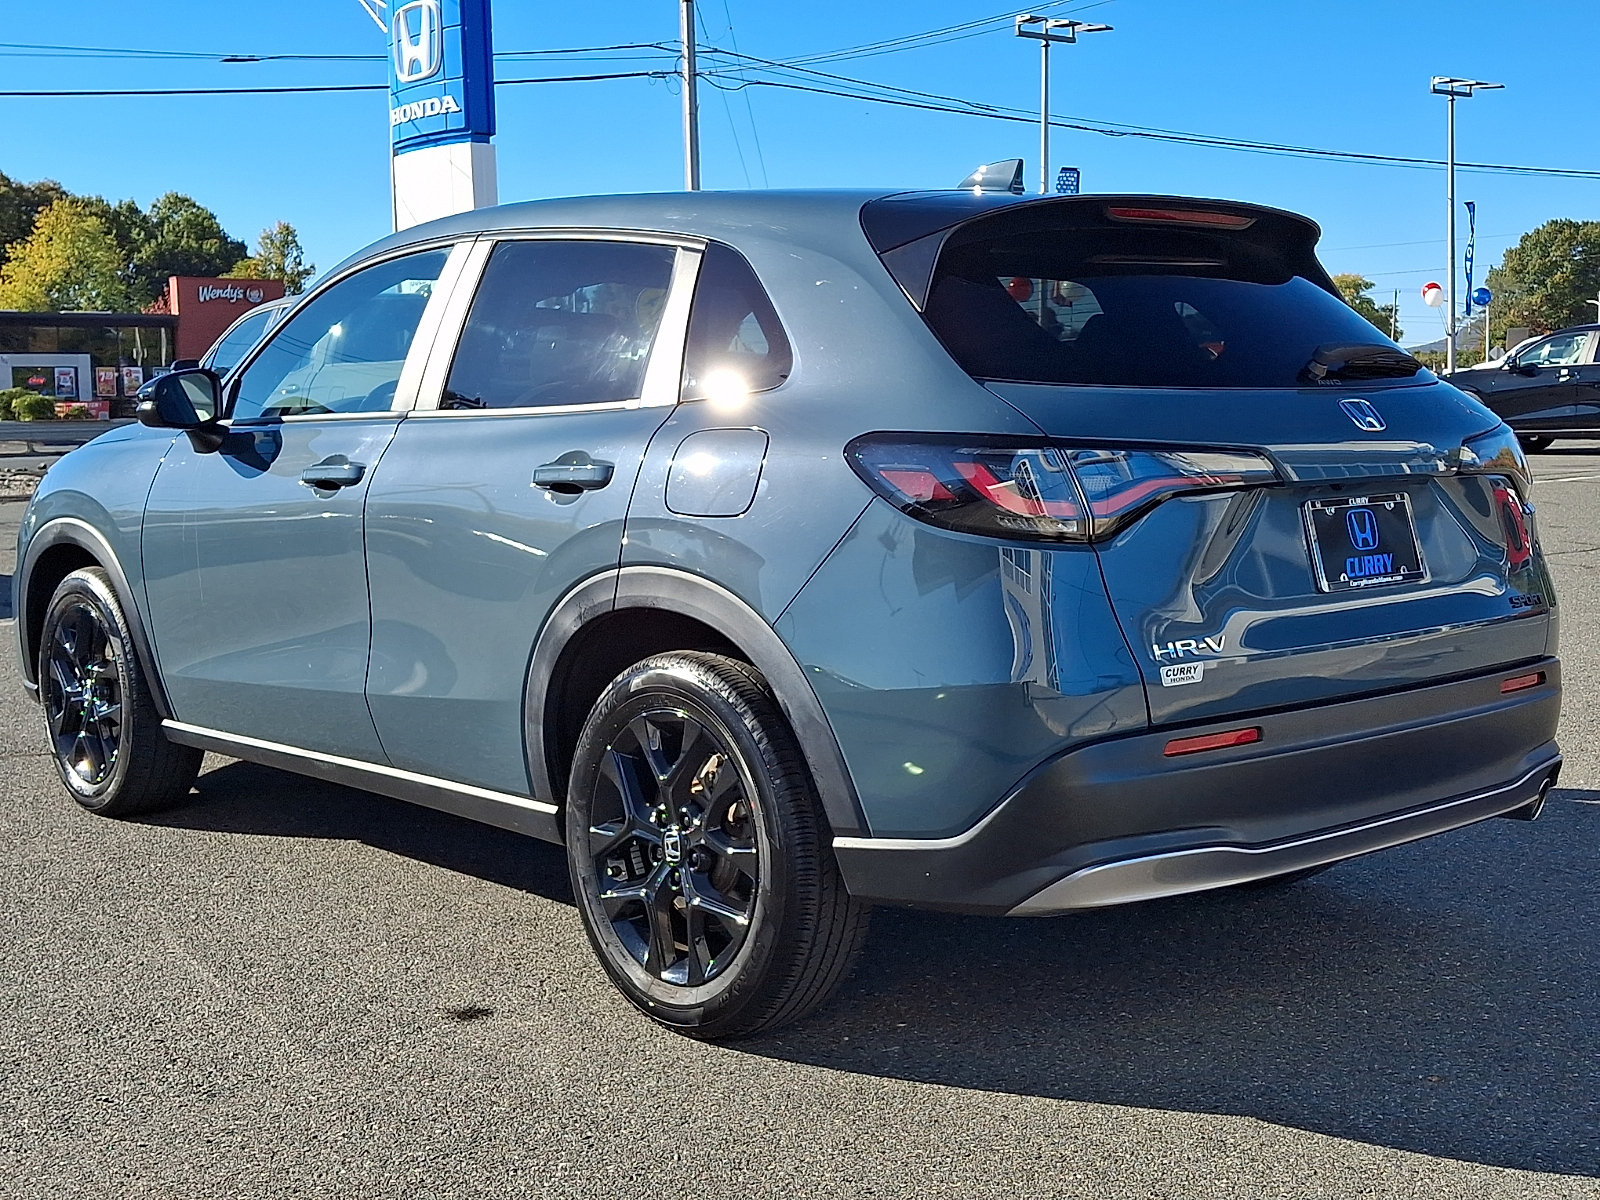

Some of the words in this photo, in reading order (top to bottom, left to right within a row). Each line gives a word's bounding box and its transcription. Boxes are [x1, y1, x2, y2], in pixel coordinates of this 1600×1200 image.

[391, 94, 462, 127] HONDA
[199, 284, 244, 303] Wendy's
[1348, 497, 1369, 506] CURRY
[1346, 553, 1393, 577] CURRY
[1153, 634, 1226, 661] HR-V
[1165, 665, 1199, 678] CURRY
[1170, 675, 1196, 683] HONDA
